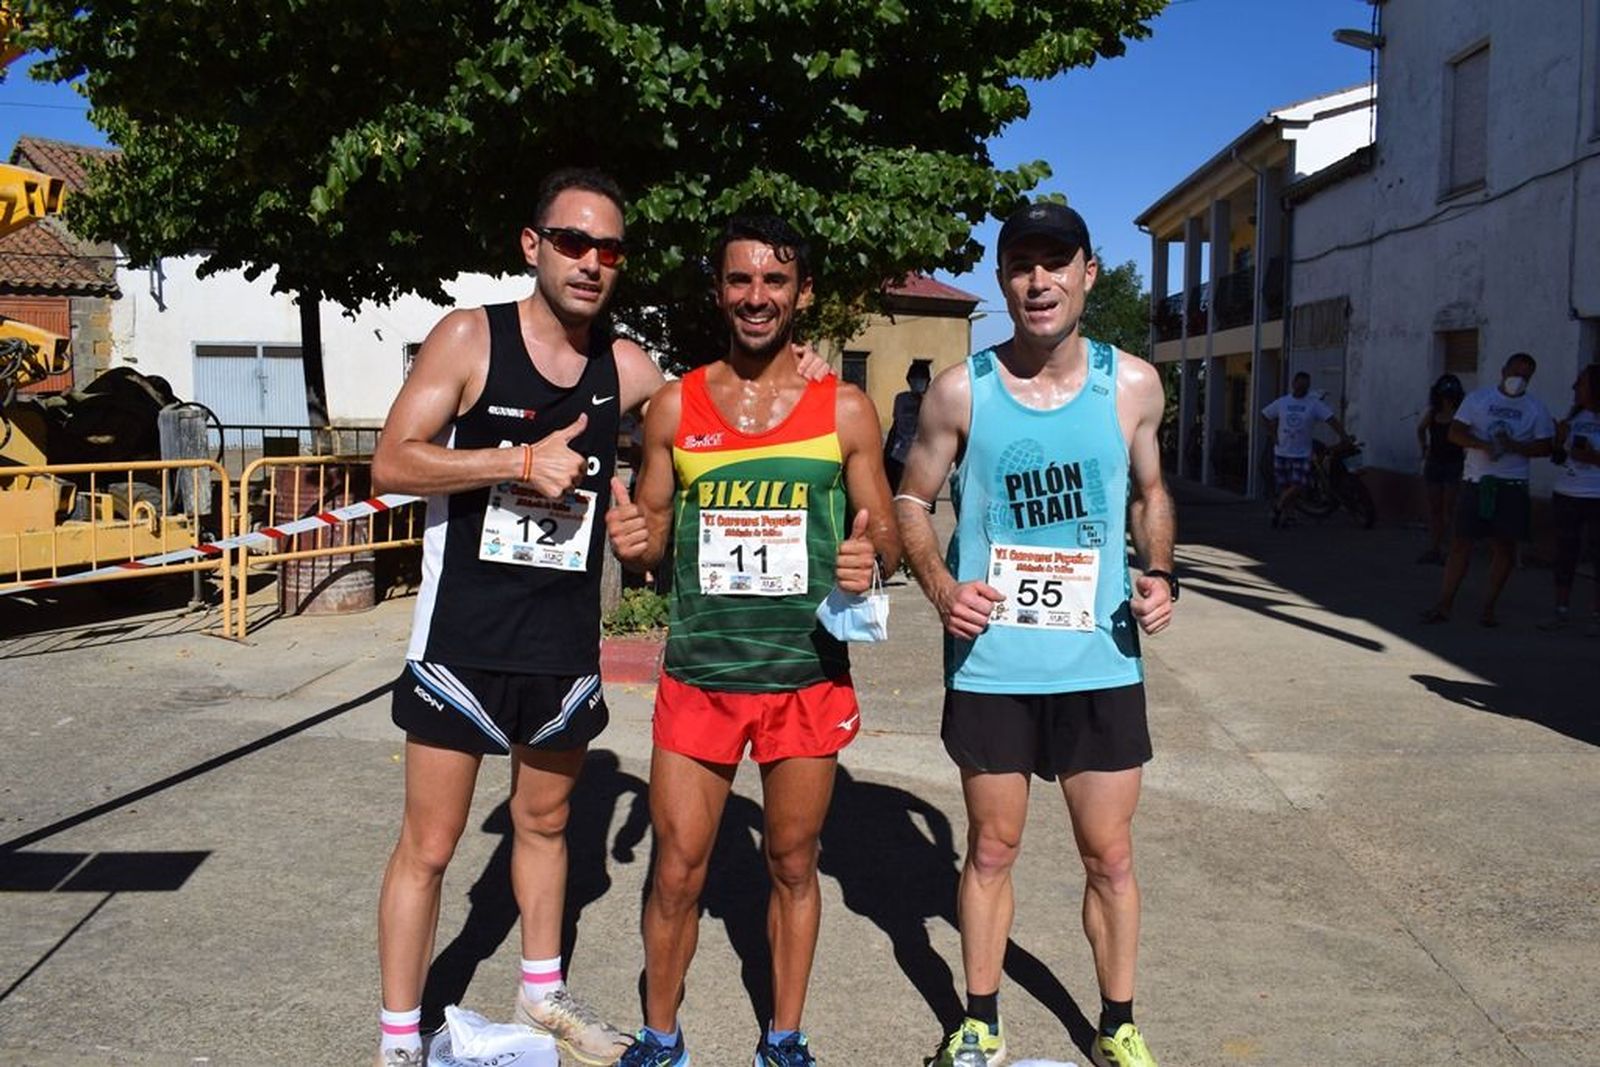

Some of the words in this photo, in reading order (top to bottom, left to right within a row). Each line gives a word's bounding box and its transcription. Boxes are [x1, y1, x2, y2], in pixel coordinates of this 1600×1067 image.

[698, 480, 810, 509] BIKILA
[1005, 461, 1083, 502] PILÓN
[1009, 491, 1088, 530] TRAIL
[516, 514, 558, 547] 12
[729, 544, 767, 574] 11
[1016, 579, 1063, 608] 55
